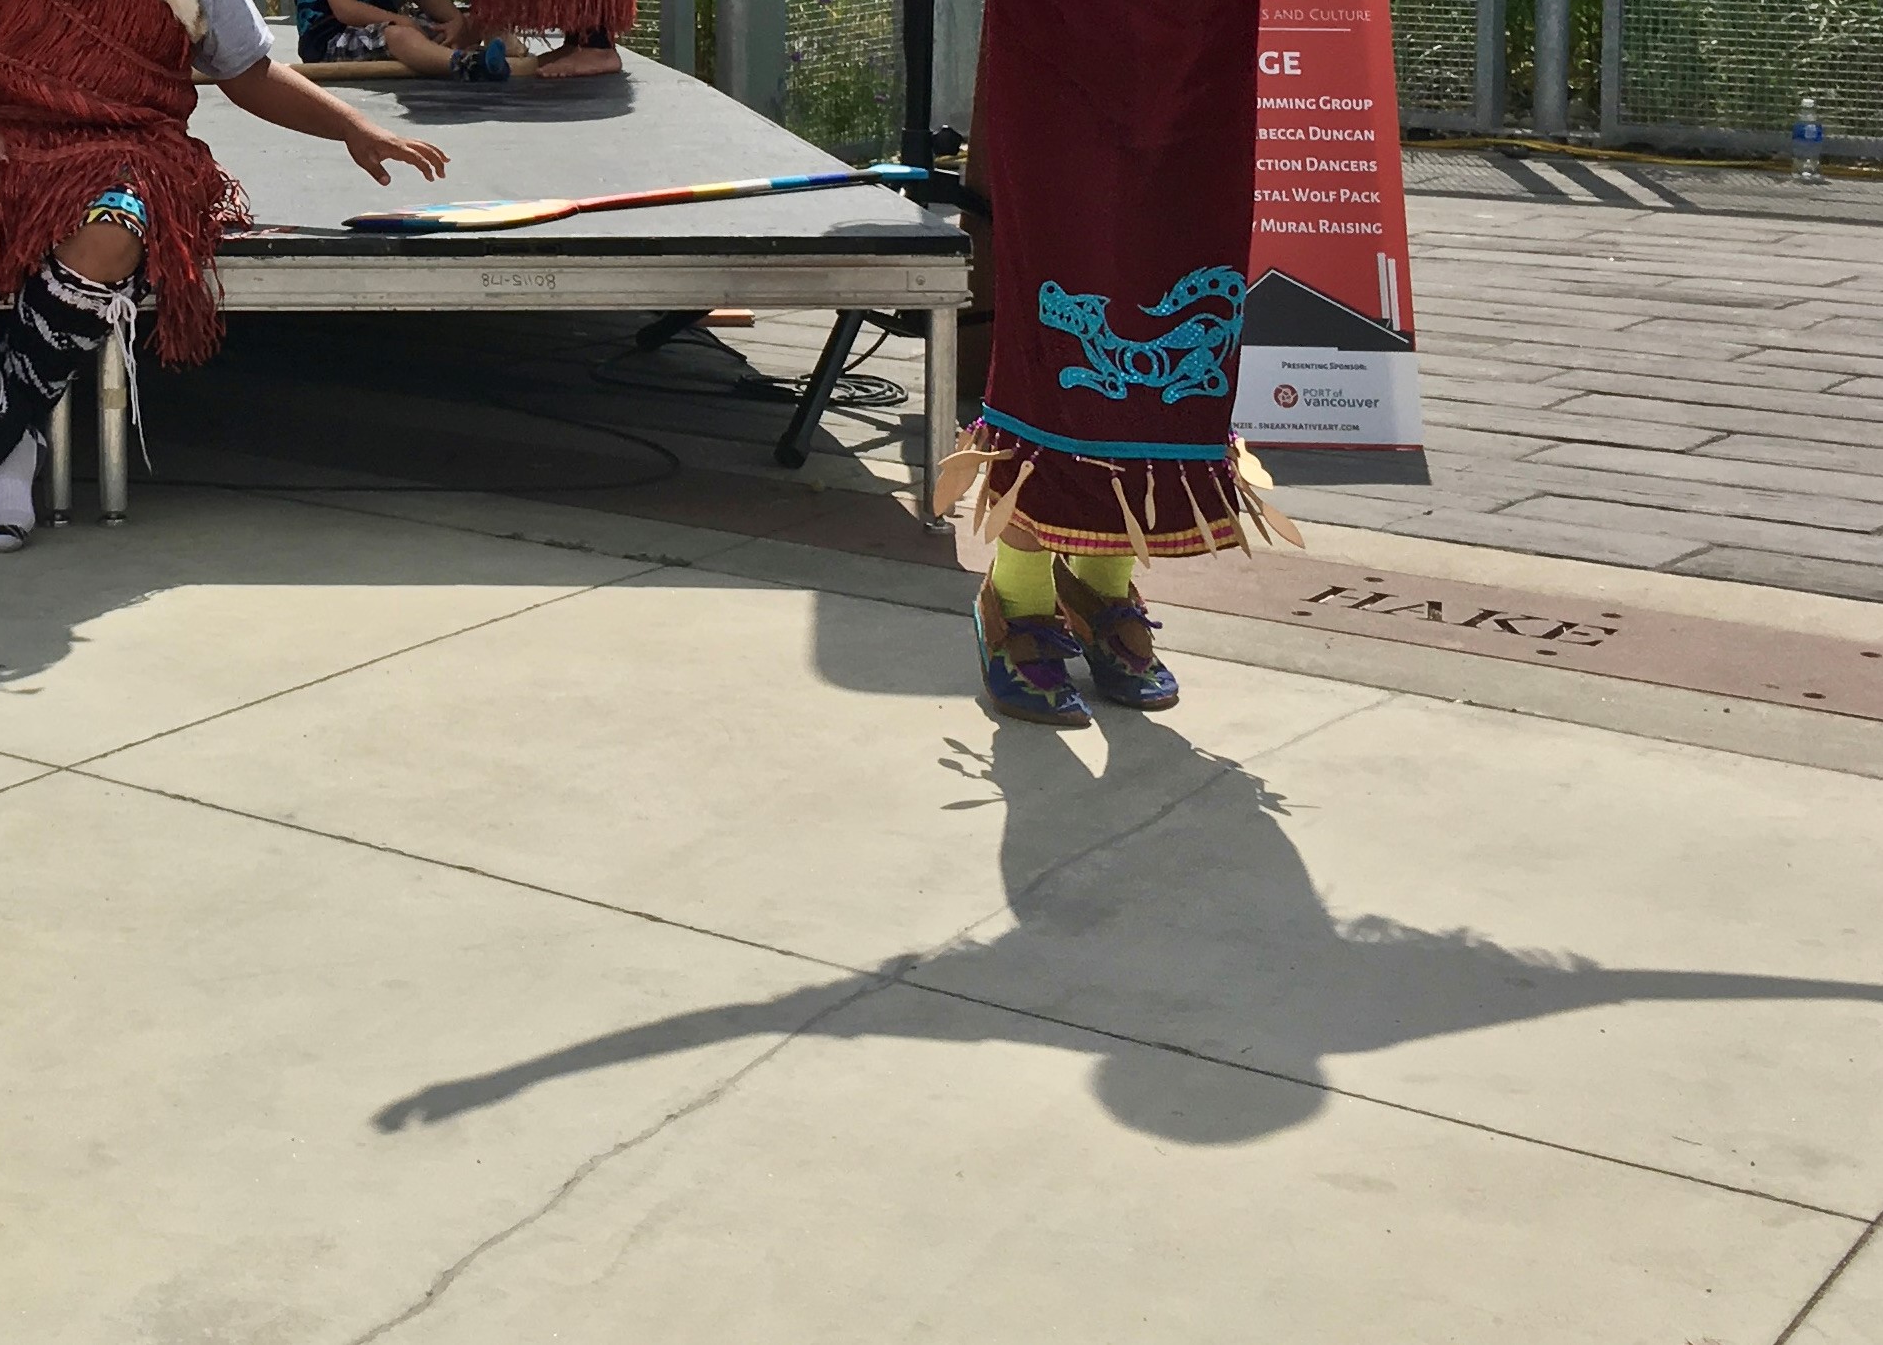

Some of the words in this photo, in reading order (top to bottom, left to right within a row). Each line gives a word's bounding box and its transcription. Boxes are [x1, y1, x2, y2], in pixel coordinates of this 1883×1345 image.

[1261, 9, 1269, 20] S
[1274, 9, 1304, 21] AND
[1309, 8, 1371, 22] CULTURE
[1258, 51, 1302, 75] GE
[1319, 95, 1373, 111] GROUP
[1256, 128, 1305, 140] BECCA
[1308, 126, 1375, 141] DUNCAN
[1256, 159, 1302, 171] CTION
[1306, 157, 1378, 172] DANCERS
[1253, 189, 1290, 202] STAL
[1292, 187, 1337, 203] WOLF
[1340, 188, 1381, 203] PACK
[1260, 218, 1316, 233] MURAL
[1319, 219, 1383, 234] RAISING
[1281, 361, 1328, 370] PRESENTING
[1302, 388, 1331, 397] PORT
[1332, 388, 1343, 398] of
[1304, 397, 1380, 409] vancouver
[1233, 422, 1253, 430] NZIE
[1299, 585, 1619, 647] HAKE
